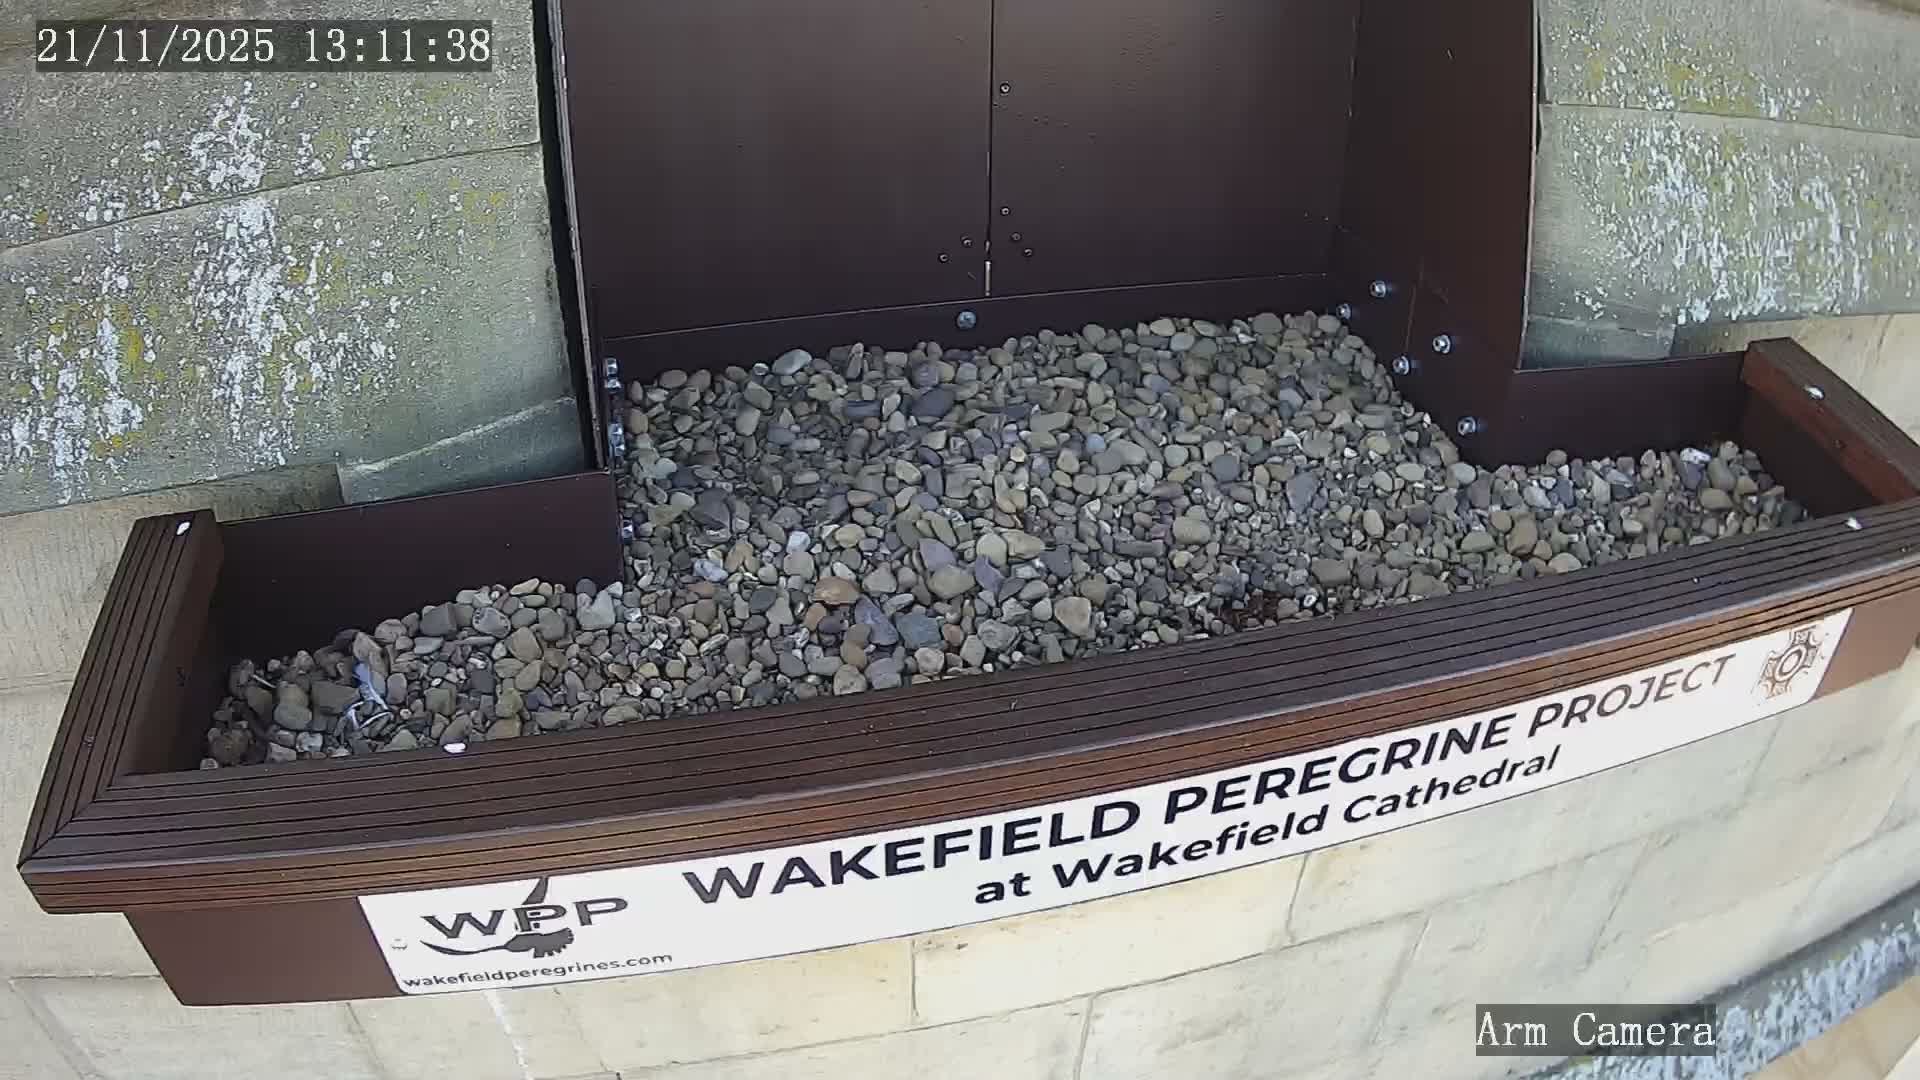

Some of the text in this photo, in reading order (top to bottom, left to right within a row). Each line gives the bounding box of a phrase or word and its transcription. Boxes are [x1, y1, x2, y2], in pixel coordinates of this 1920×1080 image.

[683, 654, 1737, 904] WAKEFIELD PEREGRINE PROJECT
[975, 745, 1560, 904] at Wakefield Cathedral
[420, 897, 628, 939] WPP
[403, 953, 673, 988] wakefieldperegrines.com
